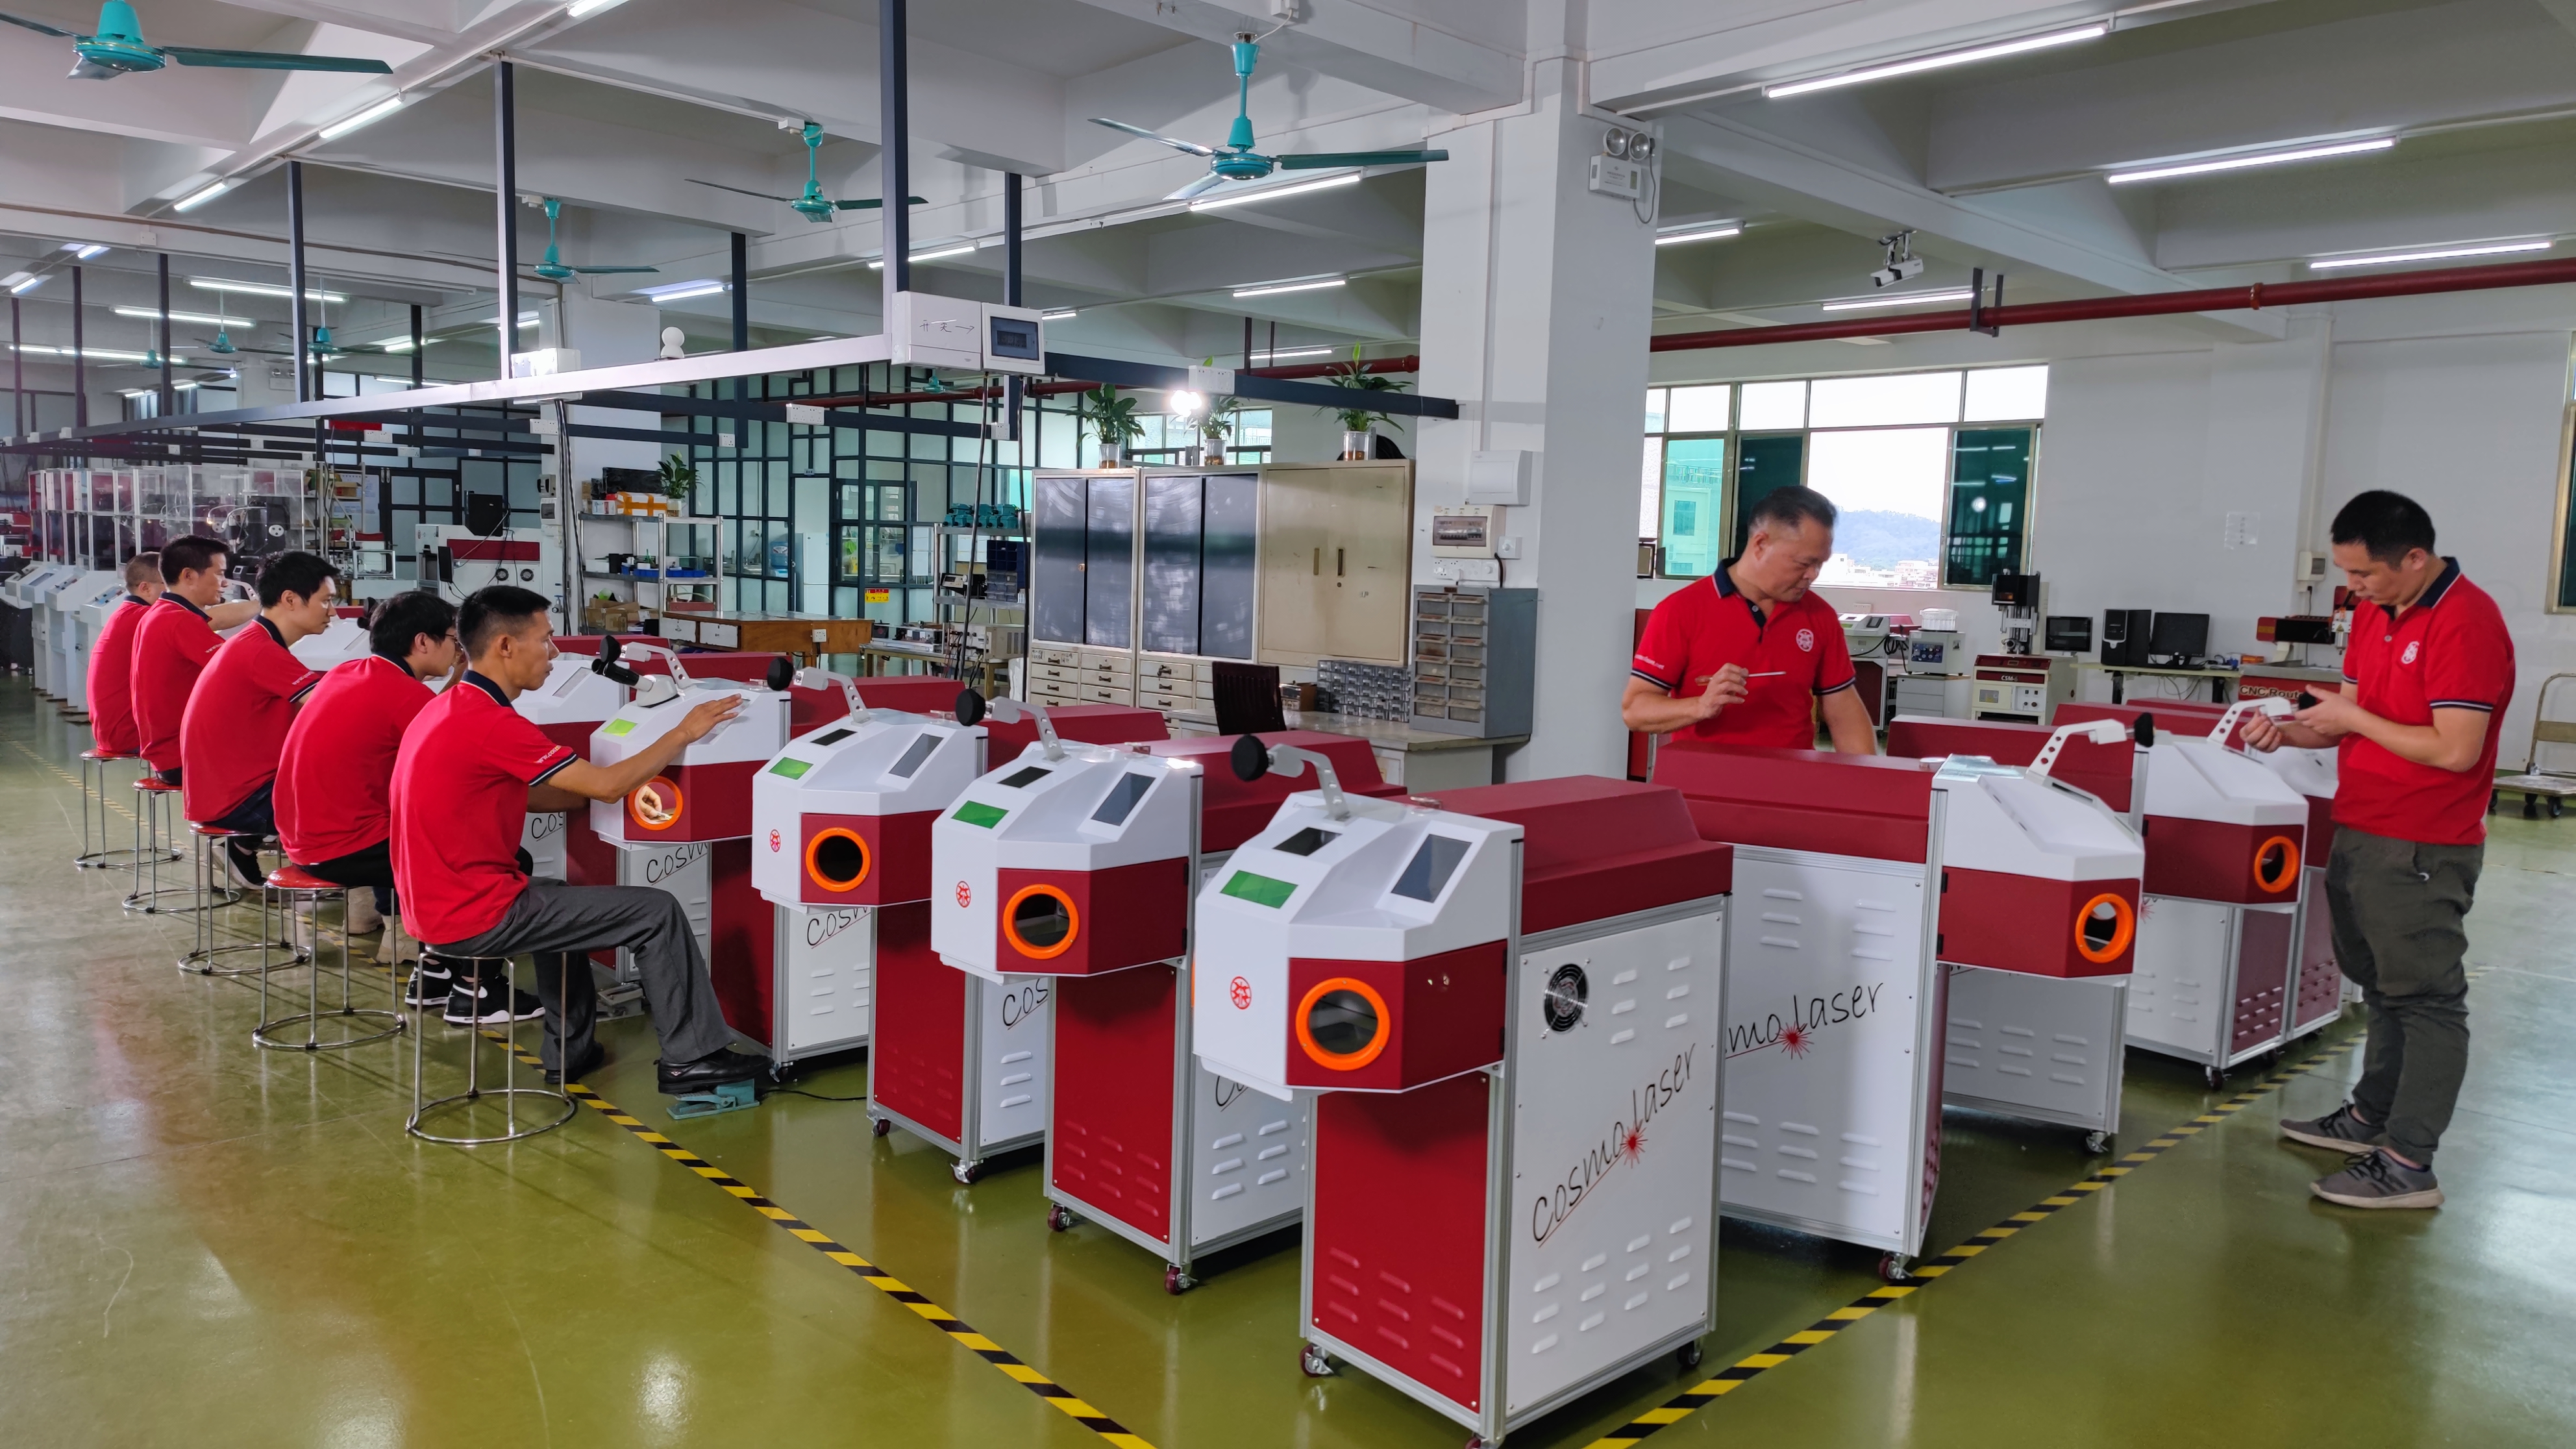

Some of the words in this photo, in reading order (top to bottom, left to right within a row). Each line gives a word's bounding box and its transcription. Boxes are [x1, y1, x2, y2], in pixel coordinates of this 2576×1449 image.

[2240, 686, 2267, 697] CNC
[2268, 688, 2303, 699] Rout
[1633, 1043, 1696, 1133] laser
